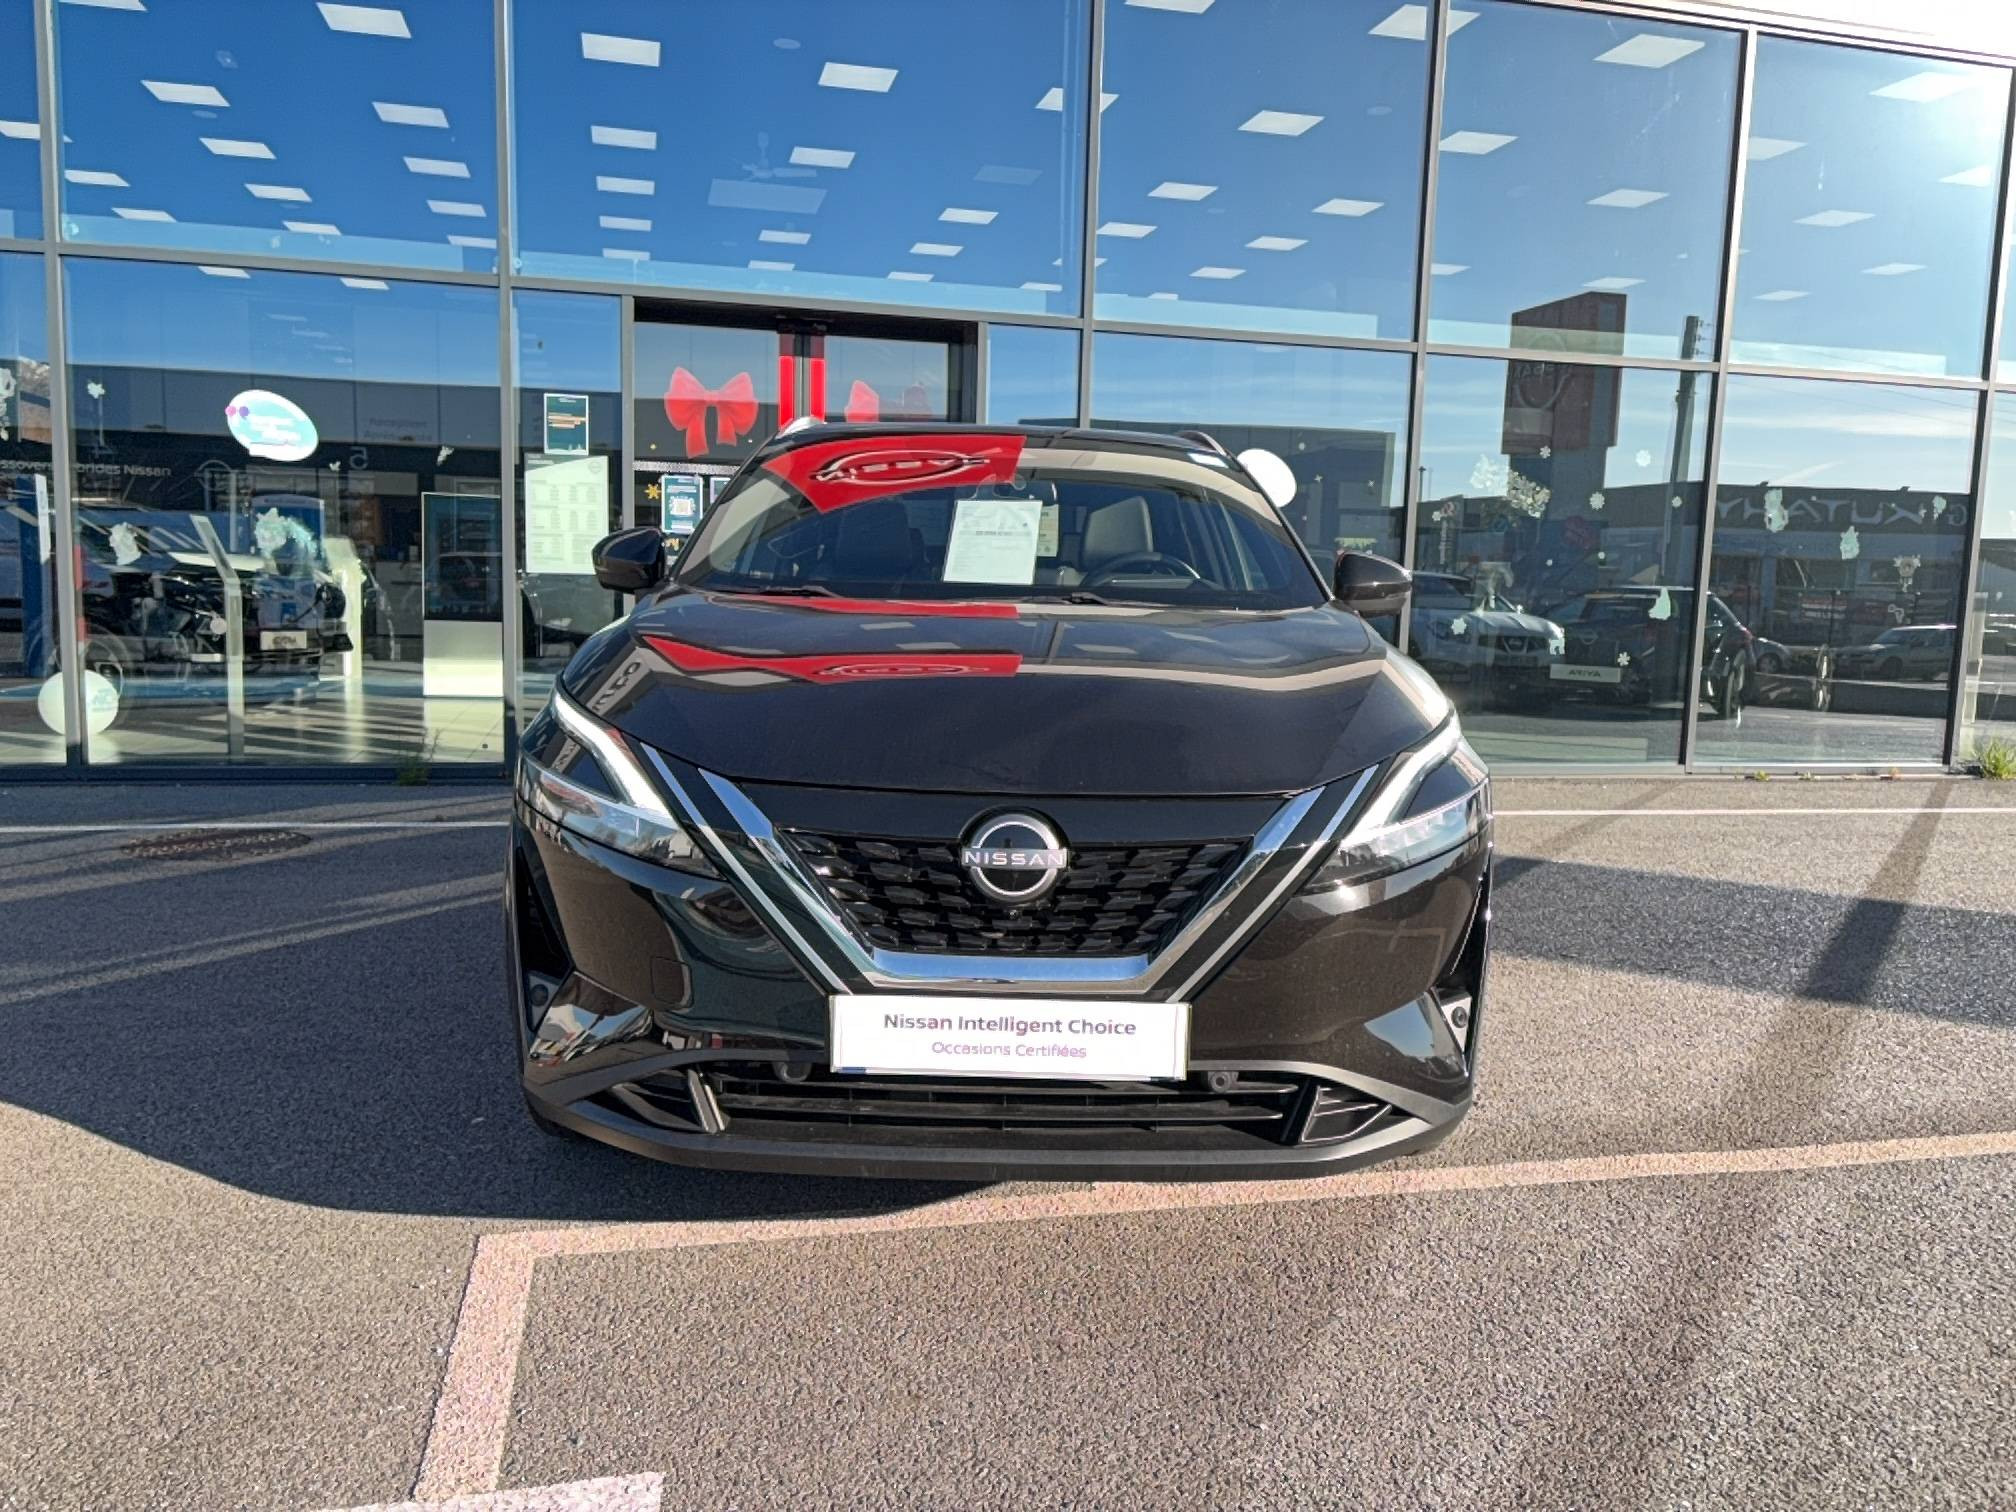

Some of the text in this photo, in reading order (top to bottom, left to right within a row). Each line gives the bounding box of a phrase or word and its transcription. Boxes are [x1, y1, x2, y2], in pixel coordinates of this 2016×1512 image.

[124, 465, 171, 477] Nissan
[963, 850, 1065, 866] NISSAN
[883, 1014, 1137, 1037] Nissan Intelligent Choice
[931, 1041, 1088, 1059] Occasions Certifiées
